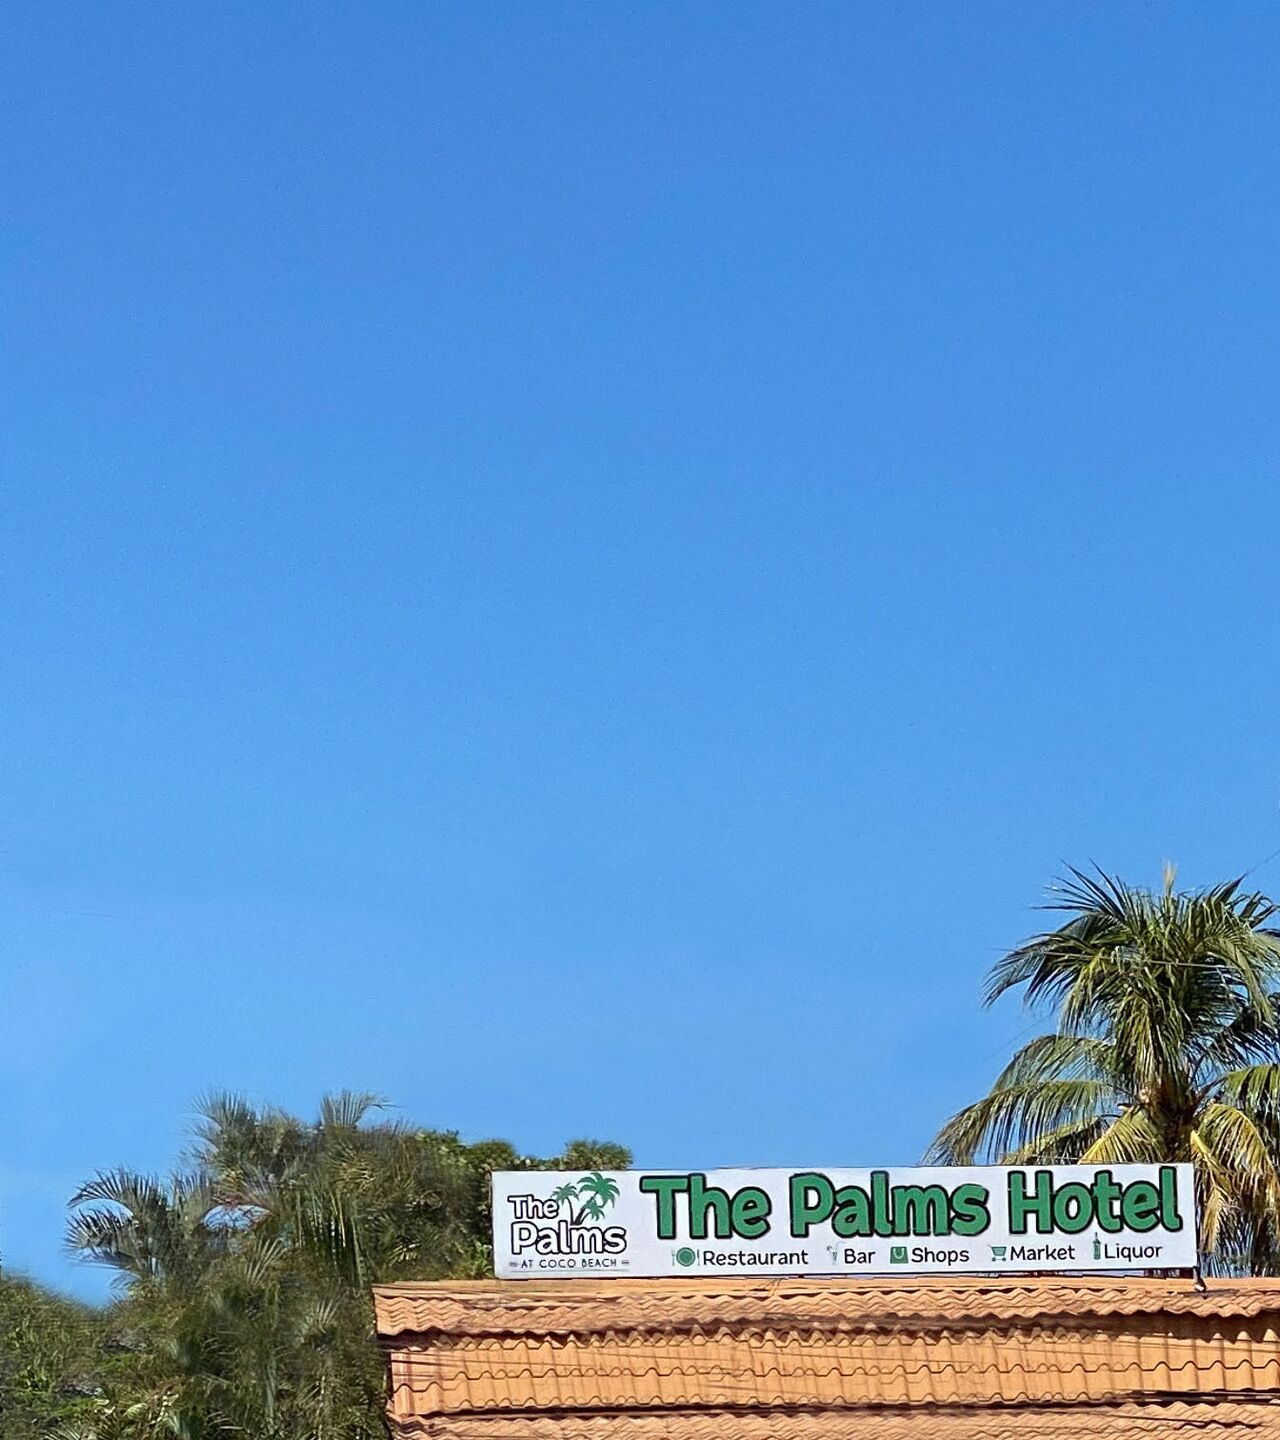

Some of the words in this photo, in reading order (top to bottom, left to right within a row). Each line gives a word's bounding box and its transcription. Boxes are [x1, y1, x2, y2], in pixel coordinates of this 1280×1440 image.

[507, 1193, 560, 1219] The
[640, 1173, 773, 1239] The
[789, 1170, 991, 1239] Palms
[1008, 1166, 1183, 1234] Hotel
[510, 1220, 627, 1255] Palms
[521, 1259, 535, 1269] AT
[539, 1259, 576, 1268] COCO
[582, 1258, 617, 1268] BEACH
[702, 1250, 809, 1267] Restaurant
[844, 1249, 876, 1264] Bar
[911, 1246, 970, 1266] Shops
[1010, 1245, 1076, 1262] Market
[1104, 1243, 1164, 1263] Liquor
